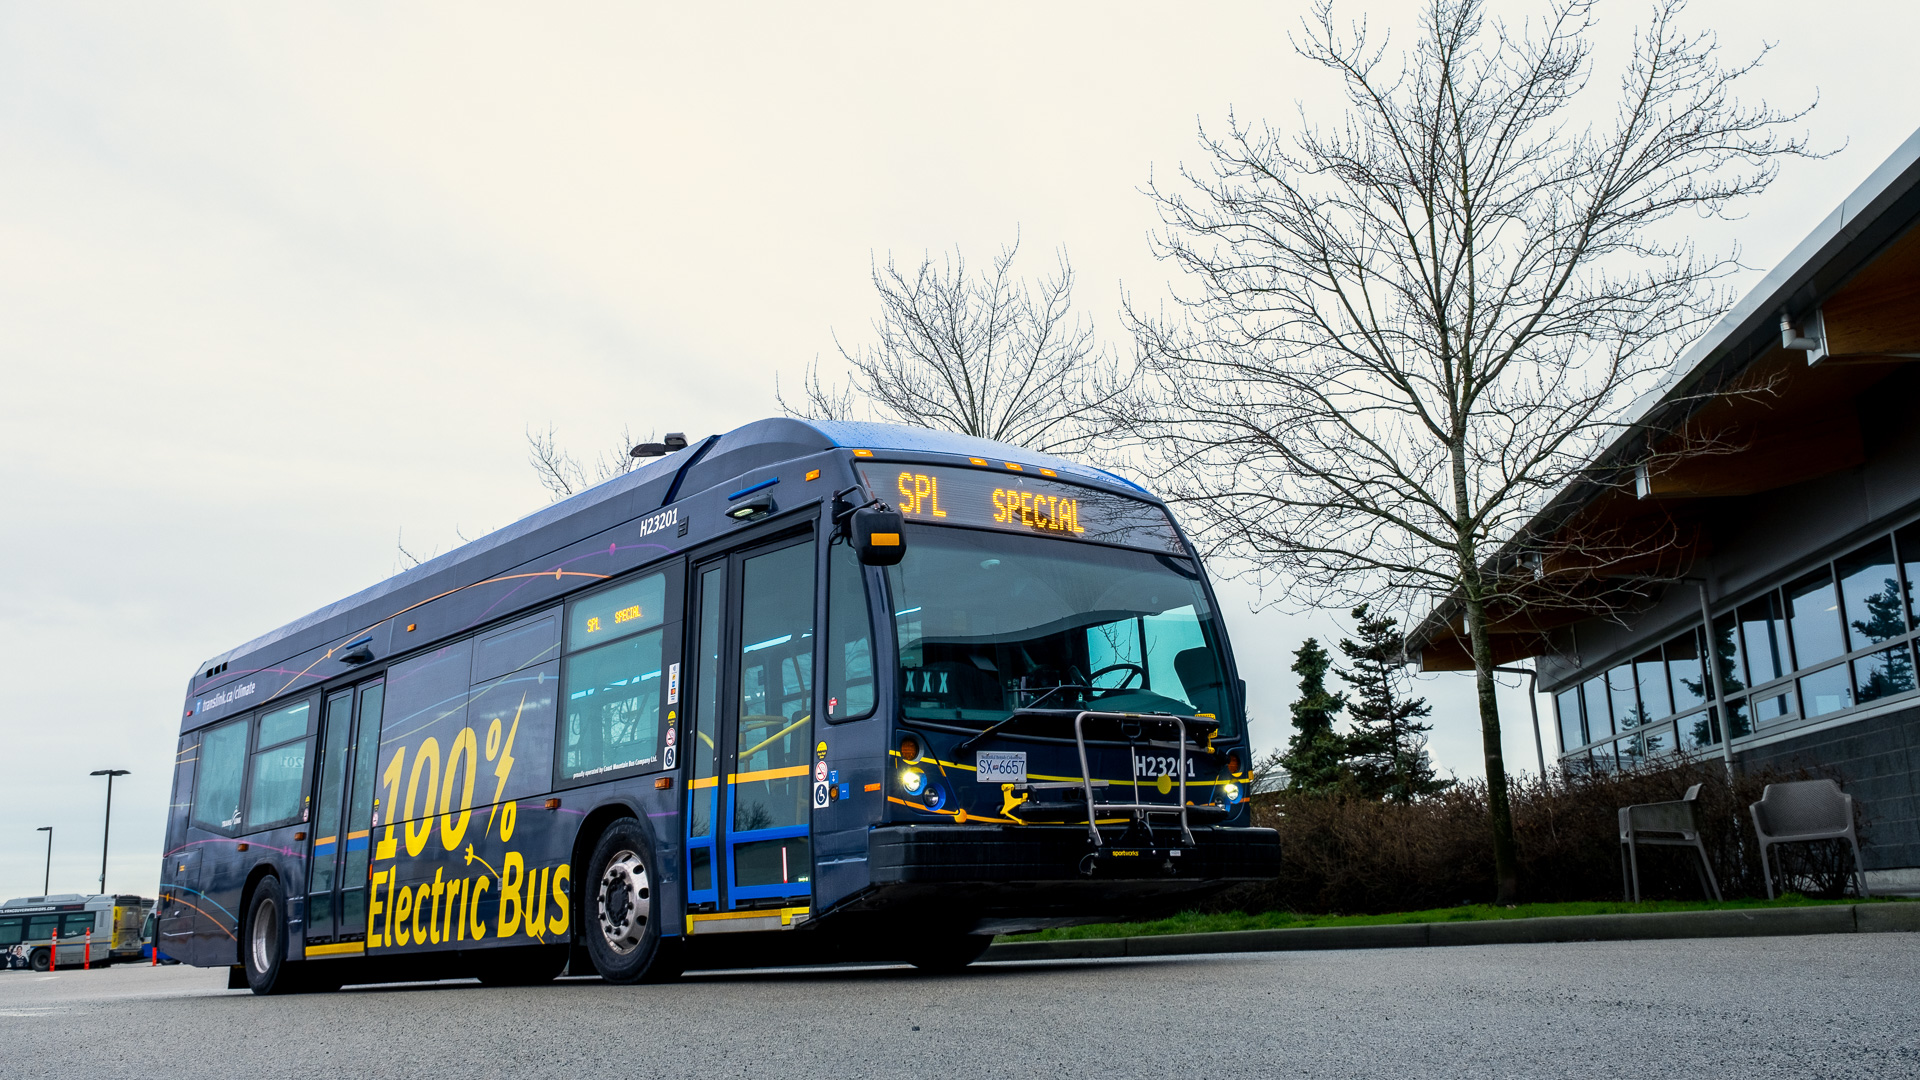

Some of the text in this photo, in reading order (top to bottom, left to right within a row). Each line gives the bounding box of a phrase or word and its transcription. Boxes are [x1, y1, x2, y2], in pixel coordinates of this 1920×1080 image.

[640, 507, 678, 537] H23201
[898, 472, 1085, 533] SPL SPECIAL
[587, 604, 642, 633] SPL SPECIAL
[202, 681, 256, 712] translink.ca/climate
[375, 690, 527, 861] 100%
[367, 851, 571, 948] Electric Bus
